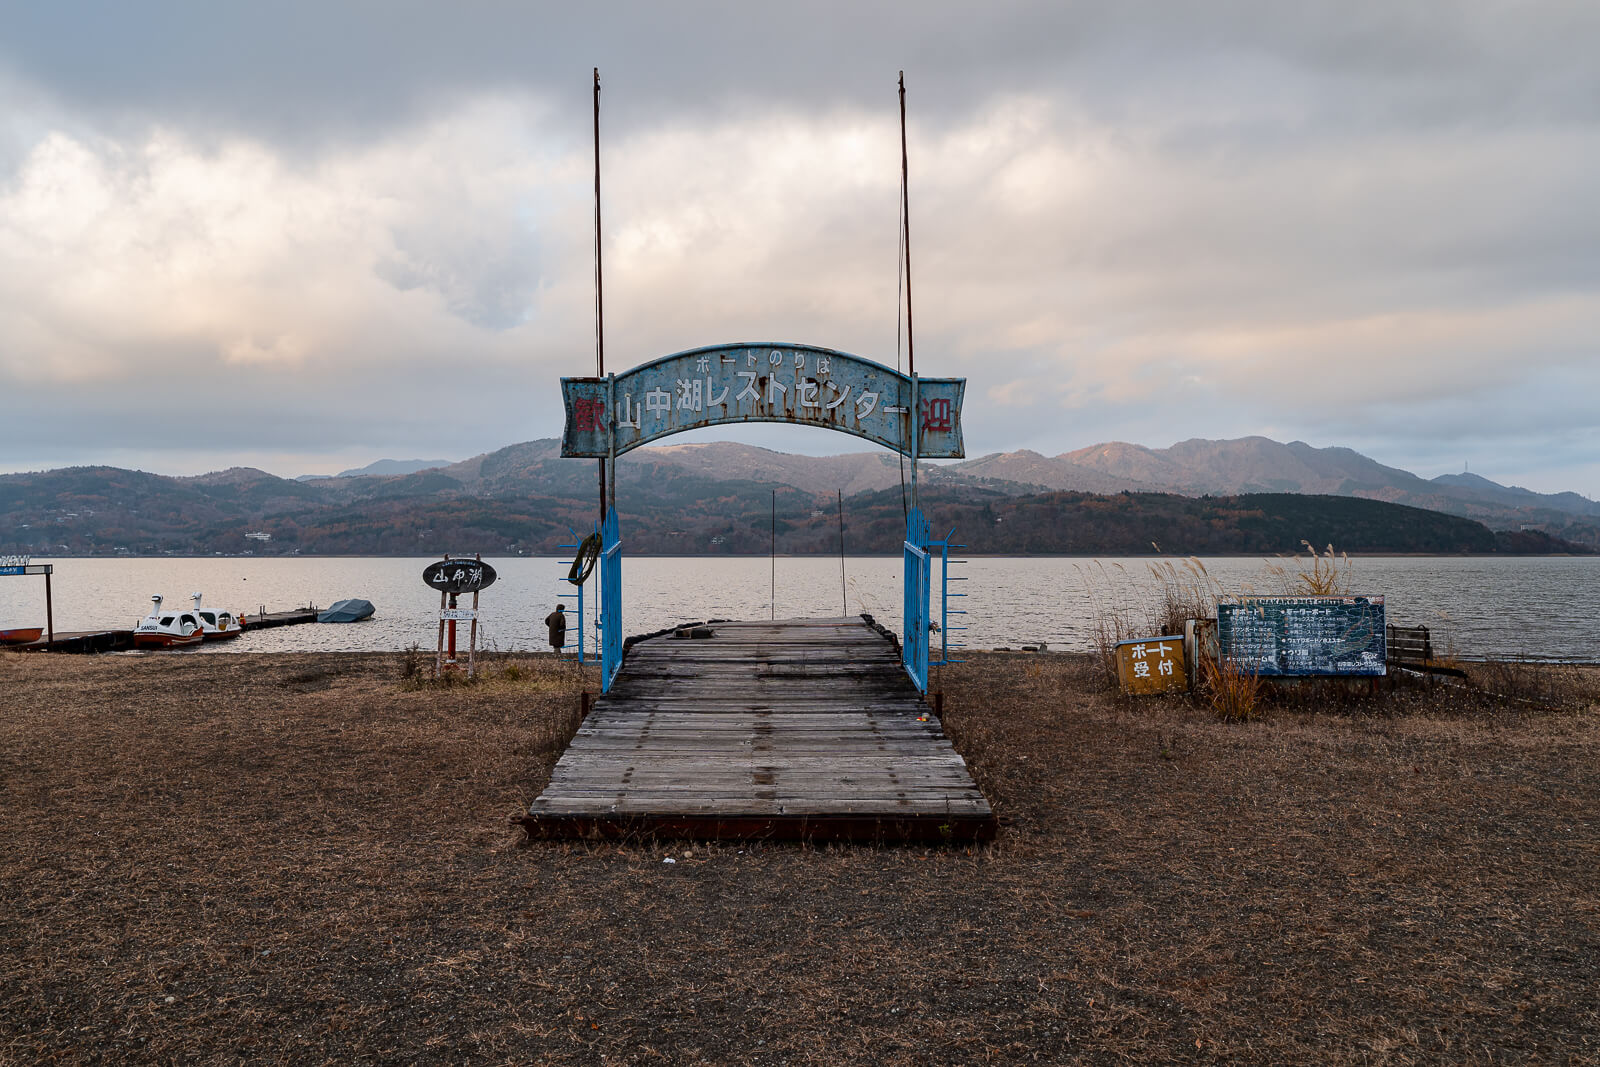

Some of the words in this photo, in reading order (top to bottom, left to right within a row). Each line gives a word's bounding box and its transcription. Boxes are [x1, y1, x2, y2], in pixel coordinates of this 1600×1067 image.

[696, 349, 831, 374] ボートのりば
[615, 371, 908, 430] 山中湖レストセンター
[921, 397, 953, 432] 迎
[1131, 642, 1173, 659] ボート
[1133, 659, 1174, 678] 受付
